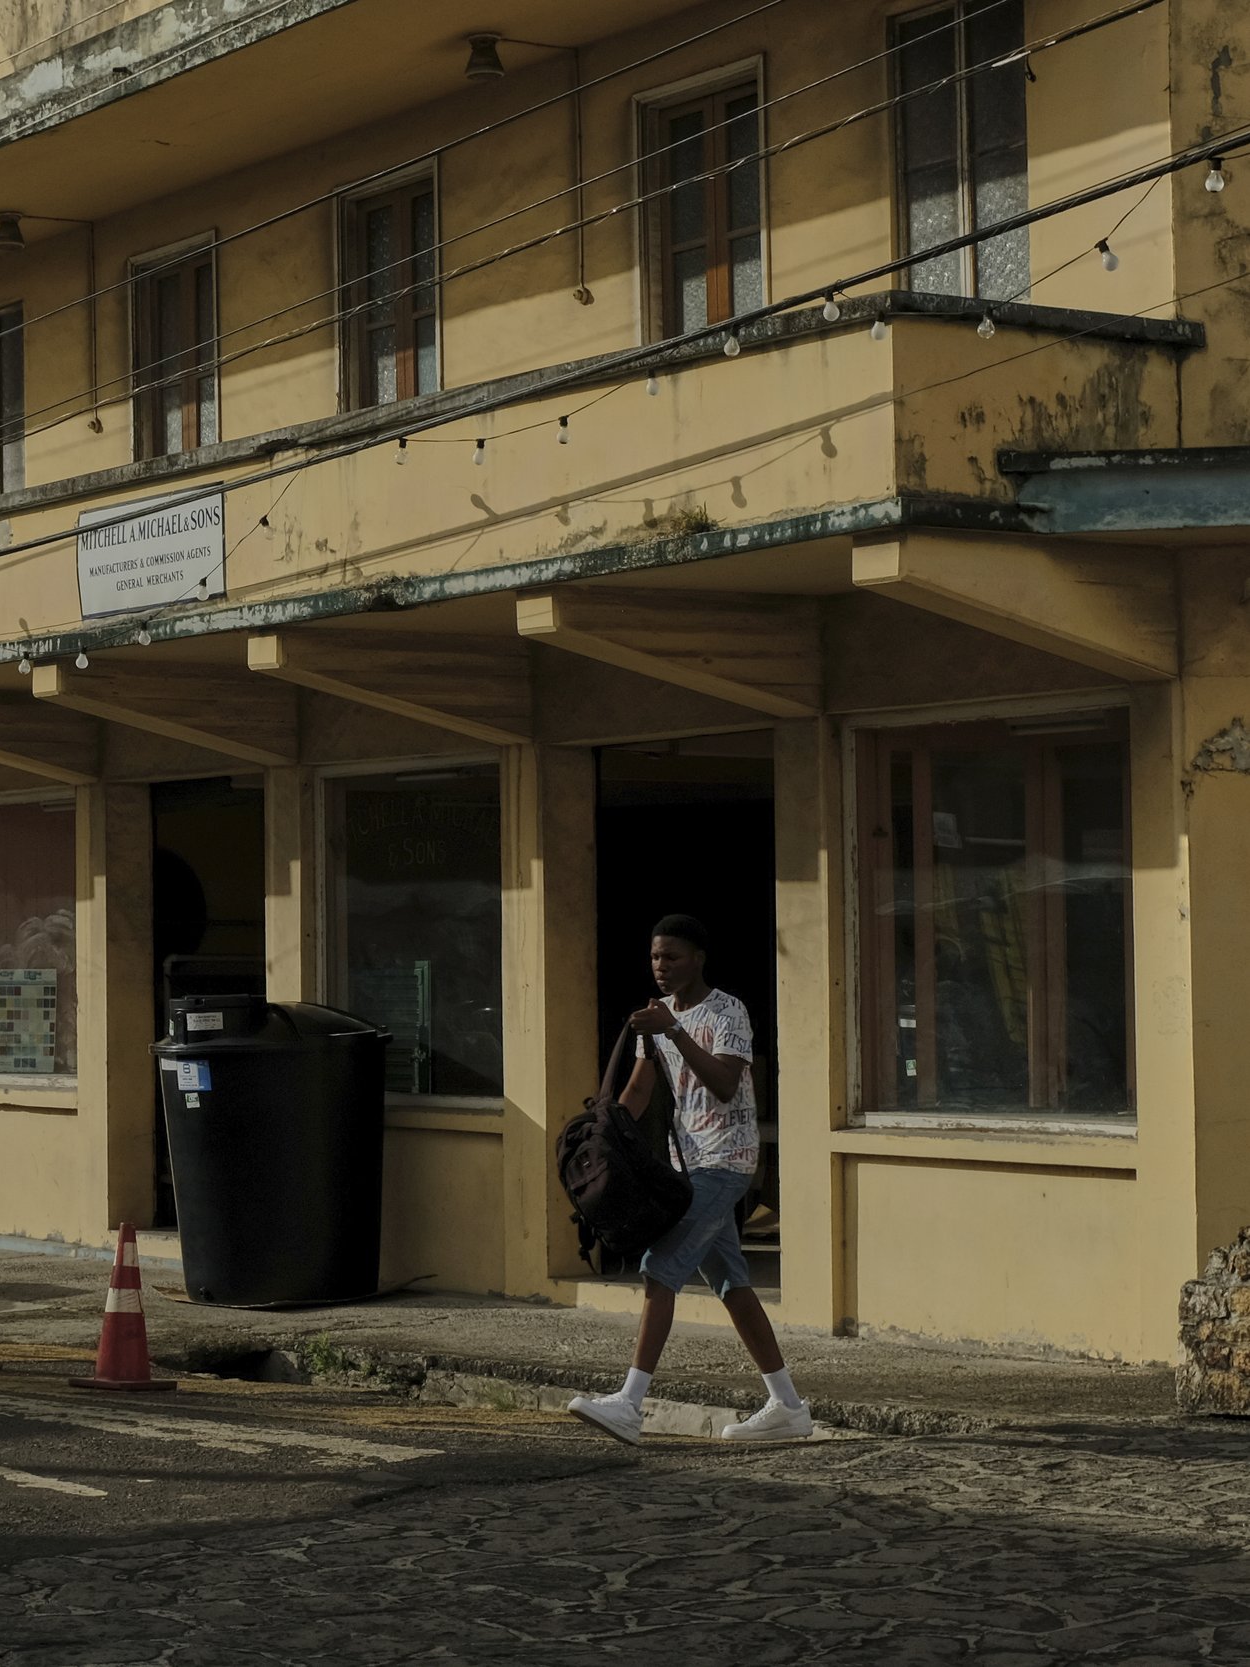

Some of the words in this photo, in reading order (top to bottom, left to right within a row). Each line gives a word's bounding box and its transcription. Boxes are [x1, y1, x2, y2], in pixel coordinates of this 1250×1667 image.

[81, 525, 127, 551] MITCHELL
[89, 560, 138, 577] MANUFACTURERS
[140, 559, 145, 568] &
[146, 550, 185, 567] COMMISSION
[187, 546, 211, 559] AGENTS
[116, 578, 143, 591] GENERAL
[146, 570, 184, 586] MERCHANTS
